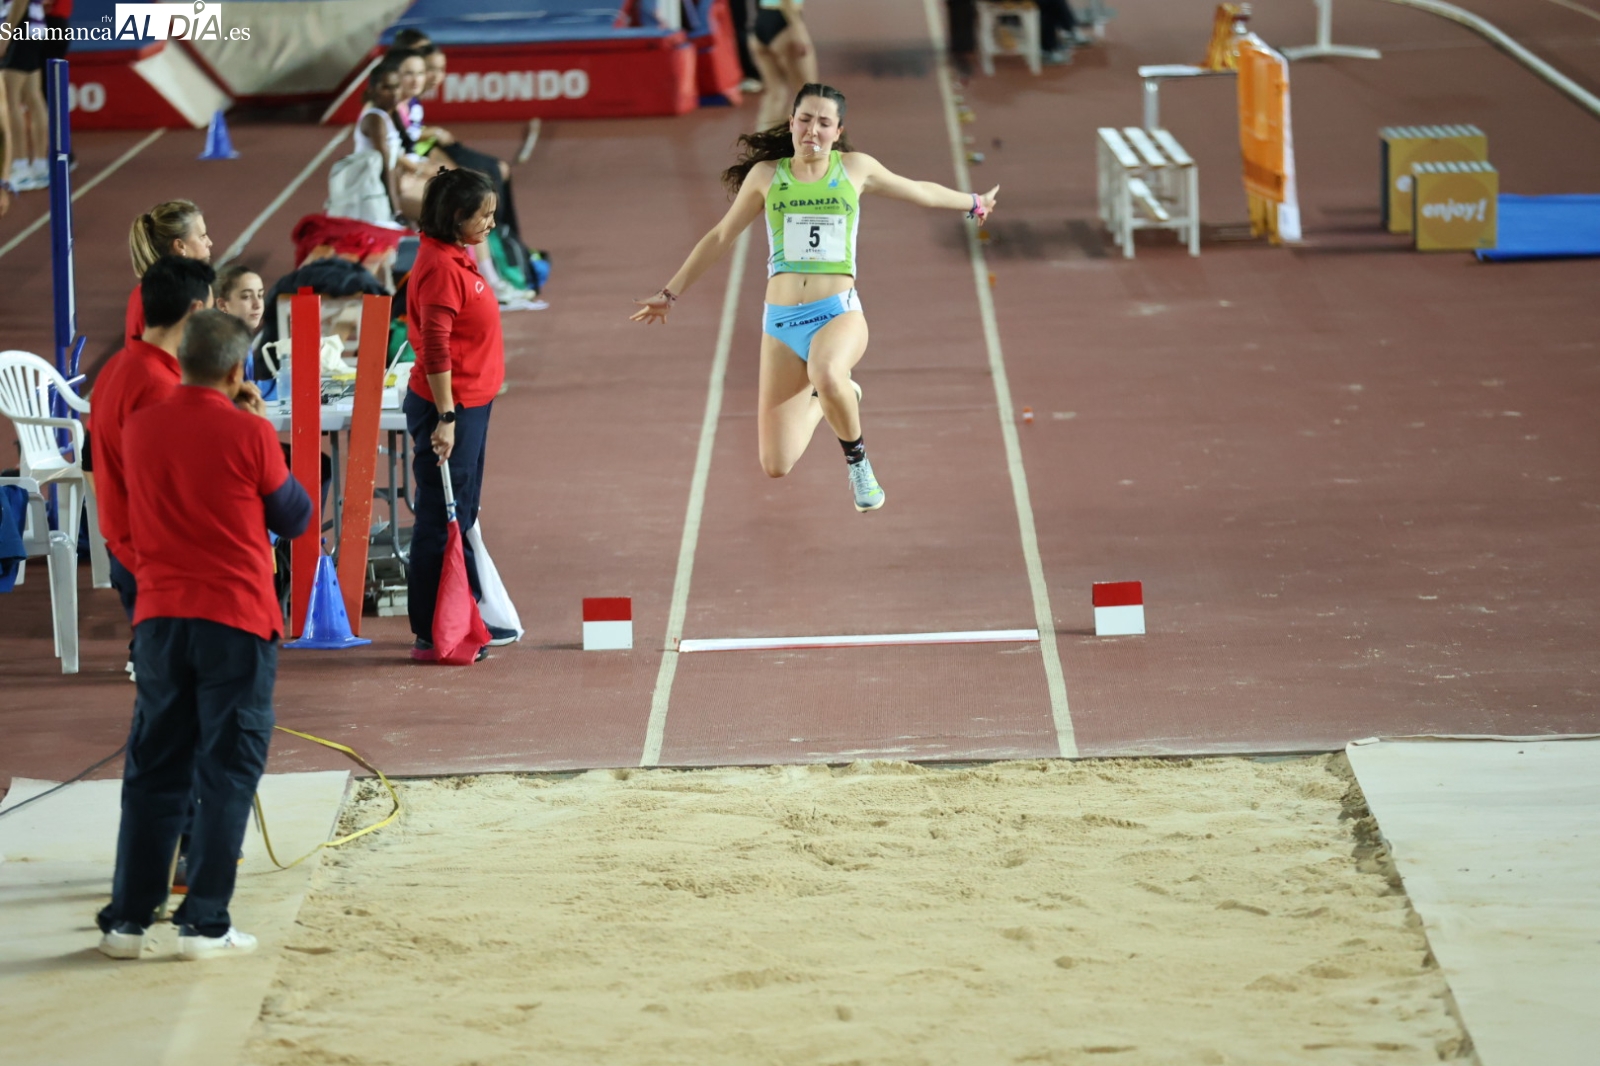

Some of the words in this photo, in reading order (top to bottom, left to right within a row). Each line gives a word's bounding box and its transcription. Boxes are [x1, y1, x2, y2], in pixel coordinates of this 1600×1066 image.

[442, 69, 589, 102] MONDO
[773, 202, 786, 211] LA
[789, 197, 839, 207] GRANJA
[1422, 198, 1487, 222] enjoy!
[809, 225, 820, 248] 5
